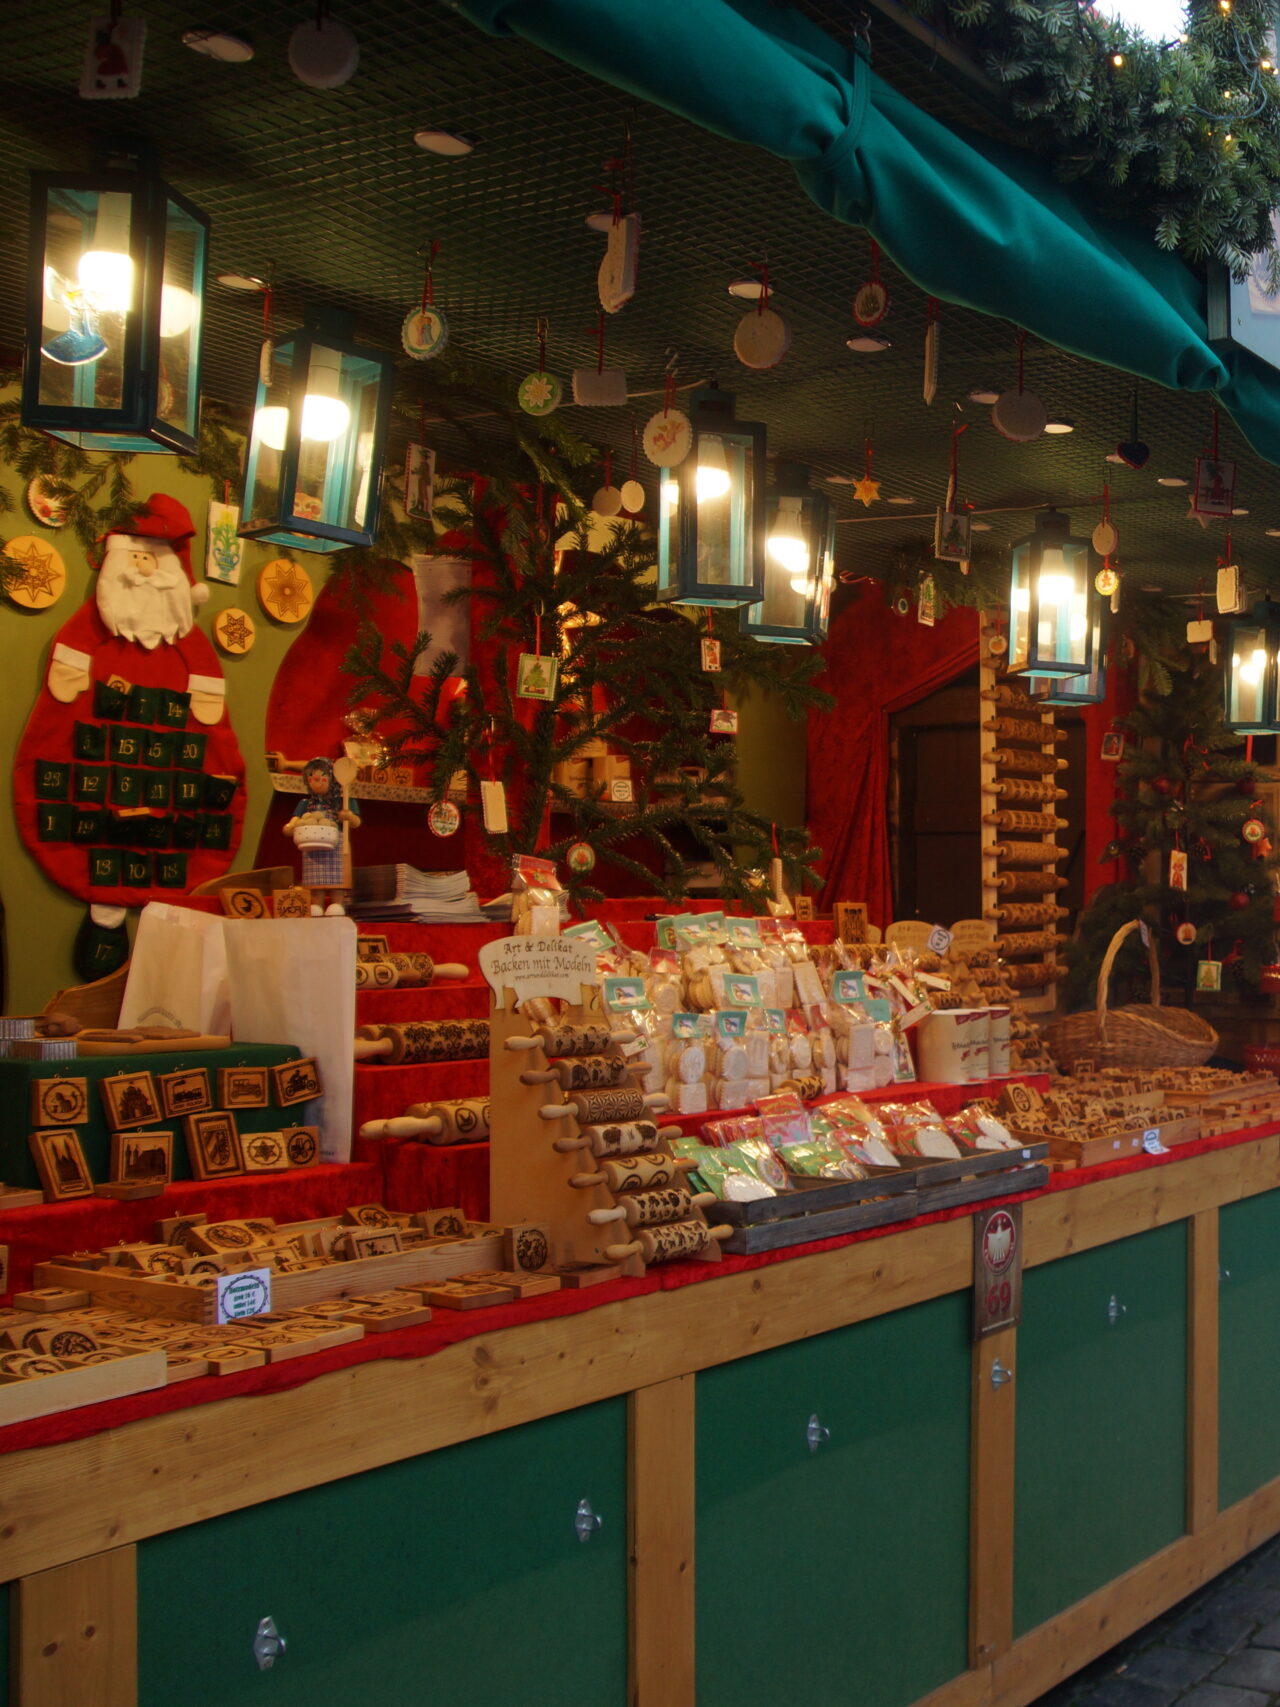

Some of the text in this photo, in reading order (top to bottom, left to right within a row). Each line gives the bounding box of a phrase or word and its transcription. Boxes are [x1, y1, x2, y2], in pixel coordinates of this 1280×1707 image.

[167, 701, 183, 719] 14
[118, 738, 136, 756] 16
[148, 742, 163, 759] 15
[183, 743, 199, 760] 20
[81, 775, 100, 792] 12
[119, 776, 131, 793] 6
[181, 783, 197, 800] 11
[46, 815, 54, 832] 1
[95, 858, 112, 876] 13
[128, 862, 146, 880] 10
[93, 943, 113, 961] 17
[504, 939, 574, 954] Art & Delikat
[490, 954, 592, 975] Backen mit Modeln
[986, 1280, 1012, 1316] 69
